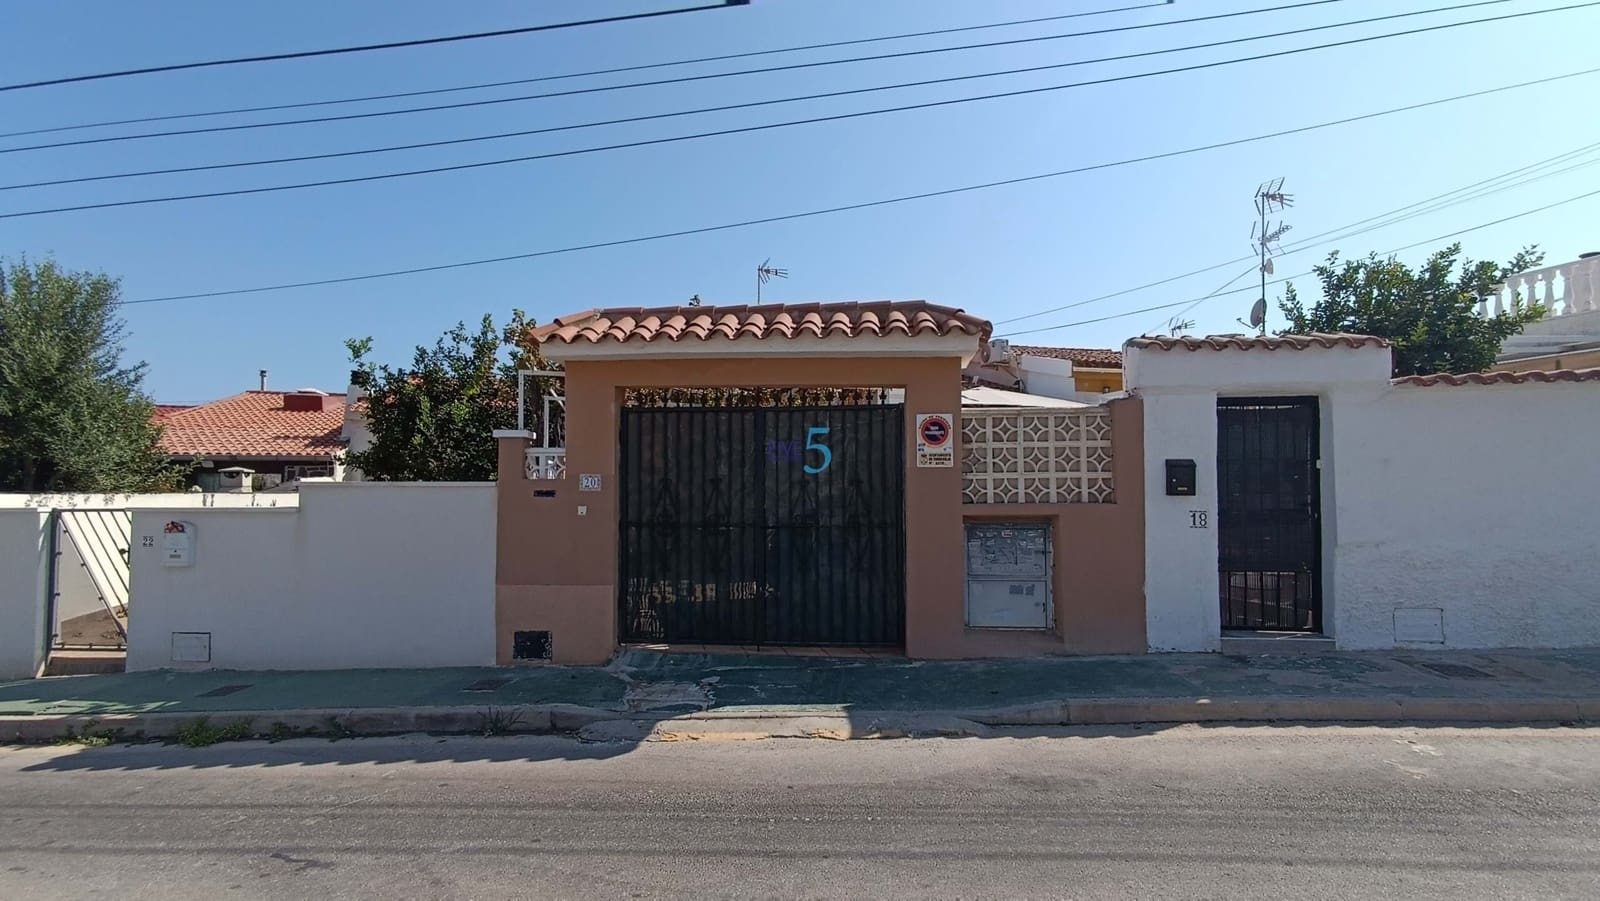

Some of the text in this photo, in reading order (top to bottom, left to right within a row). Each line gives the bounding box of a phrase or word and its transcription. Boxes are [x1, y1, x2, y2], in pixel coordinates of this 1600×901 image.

[584, 476, 598, 489] 20
[1190, 512, 1208, 527] 18
[142, 536, 154, 547] 22
